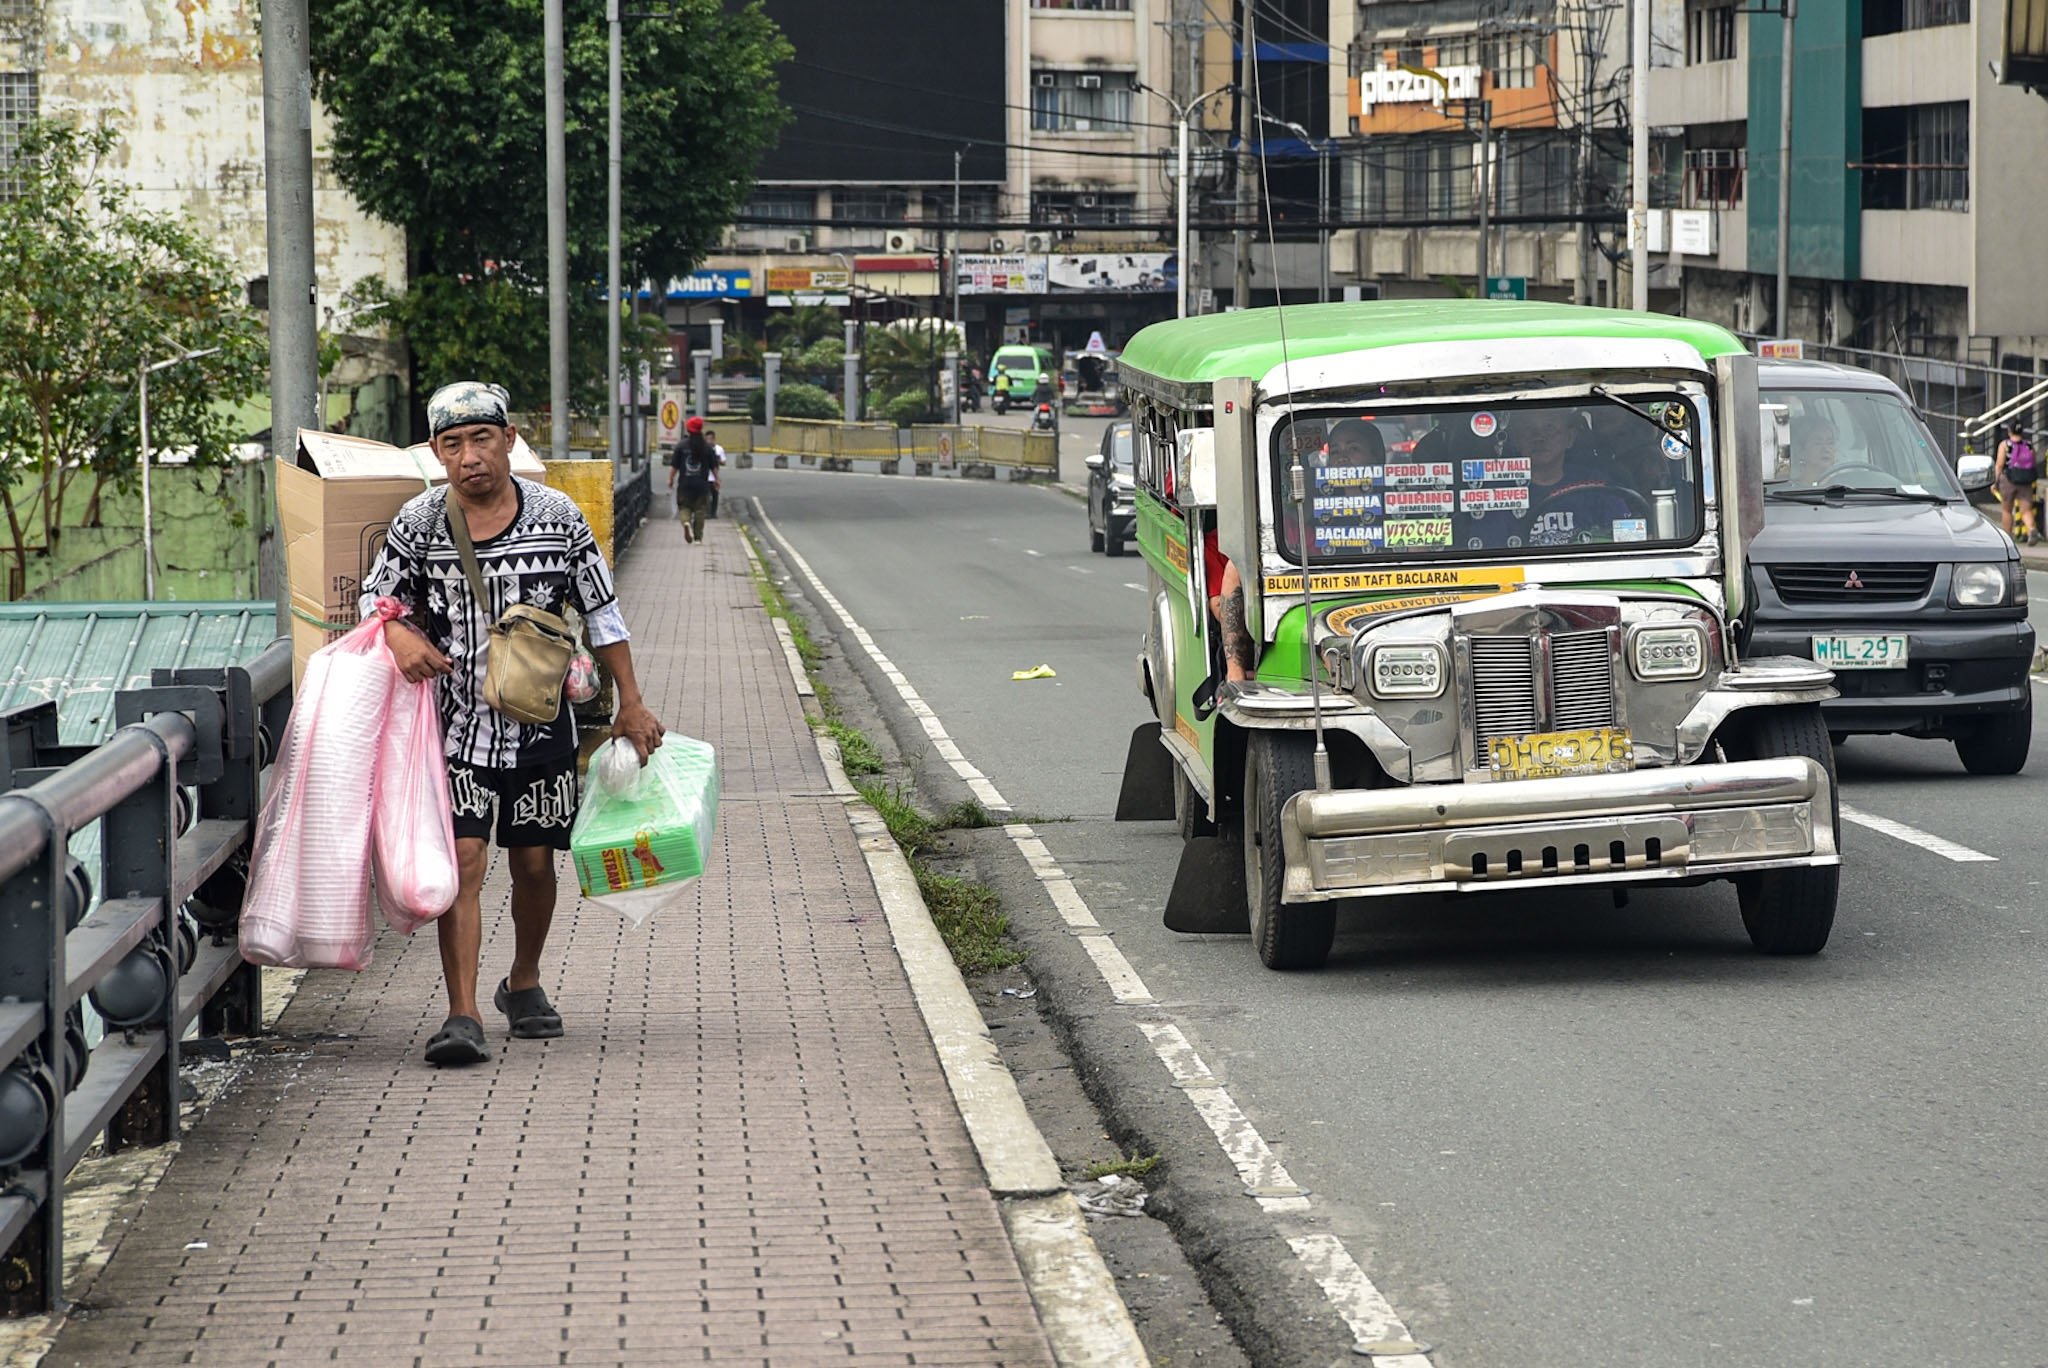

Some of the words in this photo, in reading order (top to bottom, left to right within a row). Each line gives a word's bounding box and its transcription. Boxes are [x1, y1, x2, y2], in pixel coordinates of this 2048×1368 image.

[1316, 466, 1383, 480] LIBERTAD
[1385, 465, 1426, 477] PEDRO
[1432, 464, 1453, 476] GIL
[1462, 461, 1485, 480] SM
[1485, 460, 1505, 472] CITY
[1507, 459, 1530, 471] HALL
[1313, 495, 1382, 510] BUENDIA
[1386, 492, 1453, 505] QUIRINO
[1462, 490, 1490, 503] JOSE
[1494, 489, 1528, 501] REYES
[1316, 527, 1382, 541] BACLARAN
[1386, 523, 1415, 538] VITO
[1417, 522, 1450, 537] CRUZ
[1344, 575, 1361, 587] SM
[1365, 574, 1392, 586] TAFT
[1396, 572, 1458, 585] BACLARAN
[1861, 639, 1903, 660] 297
